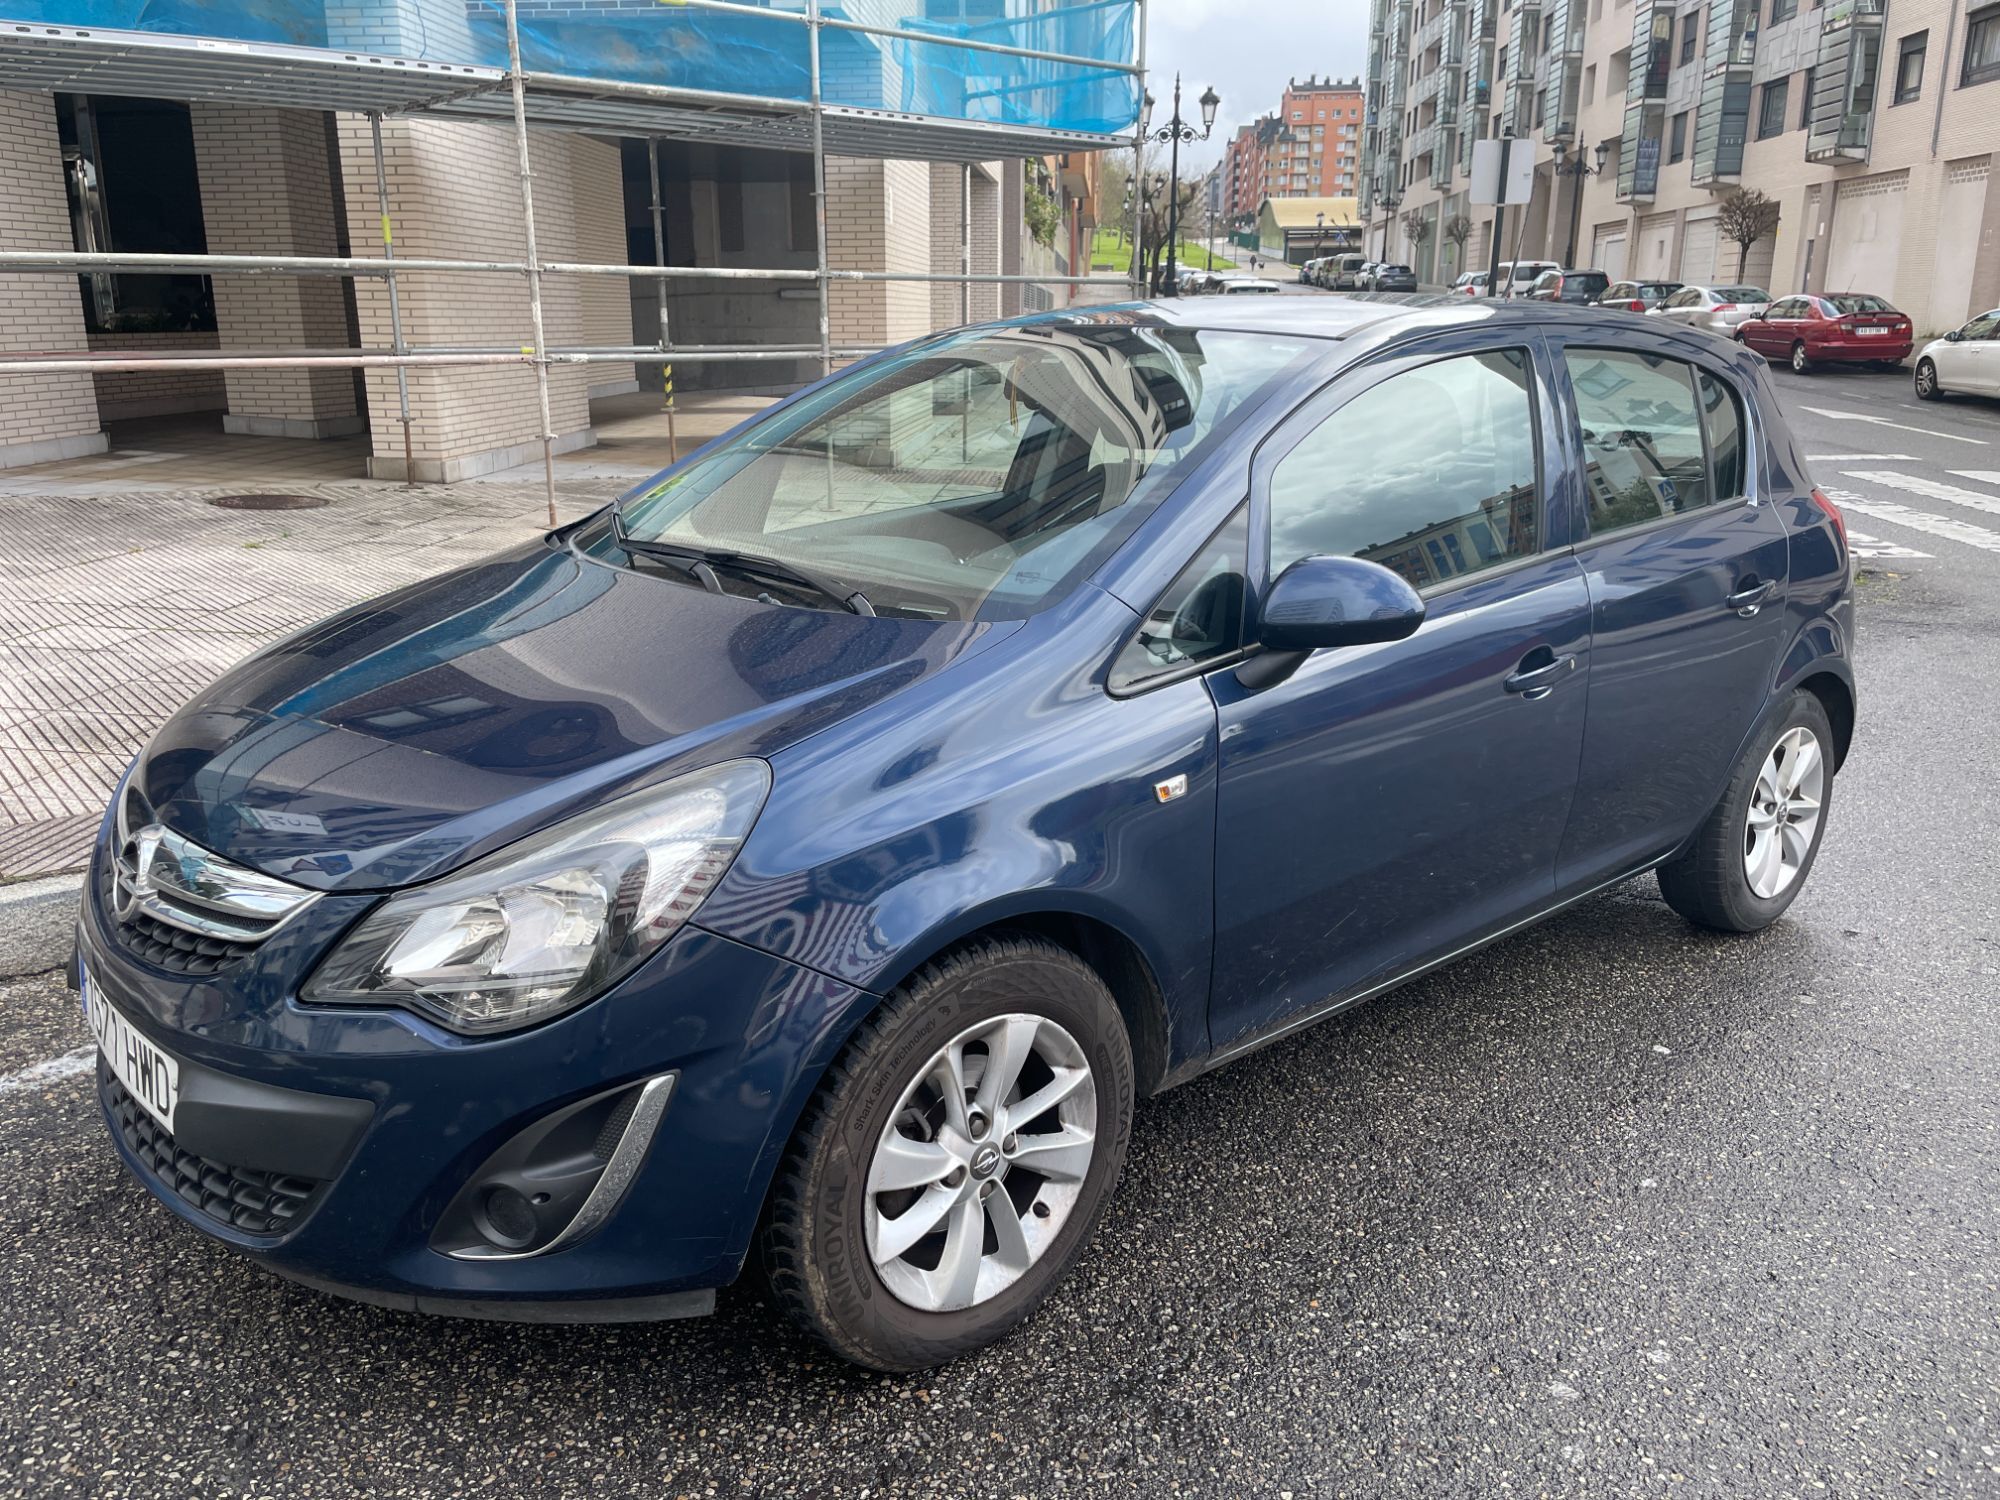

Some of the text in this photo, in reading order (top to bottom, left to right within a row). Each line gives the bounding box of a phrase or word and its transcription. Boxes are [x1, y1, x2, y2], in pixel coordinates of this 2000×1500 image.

[124, 1025, 170, 1117] HWD
[854, 1018, 937, 1132] Shark Skin Technology
[1105, 1020, 1131, 1156] UNIROYAL
[823, 1174, 865, 1326] UNIROYAL
